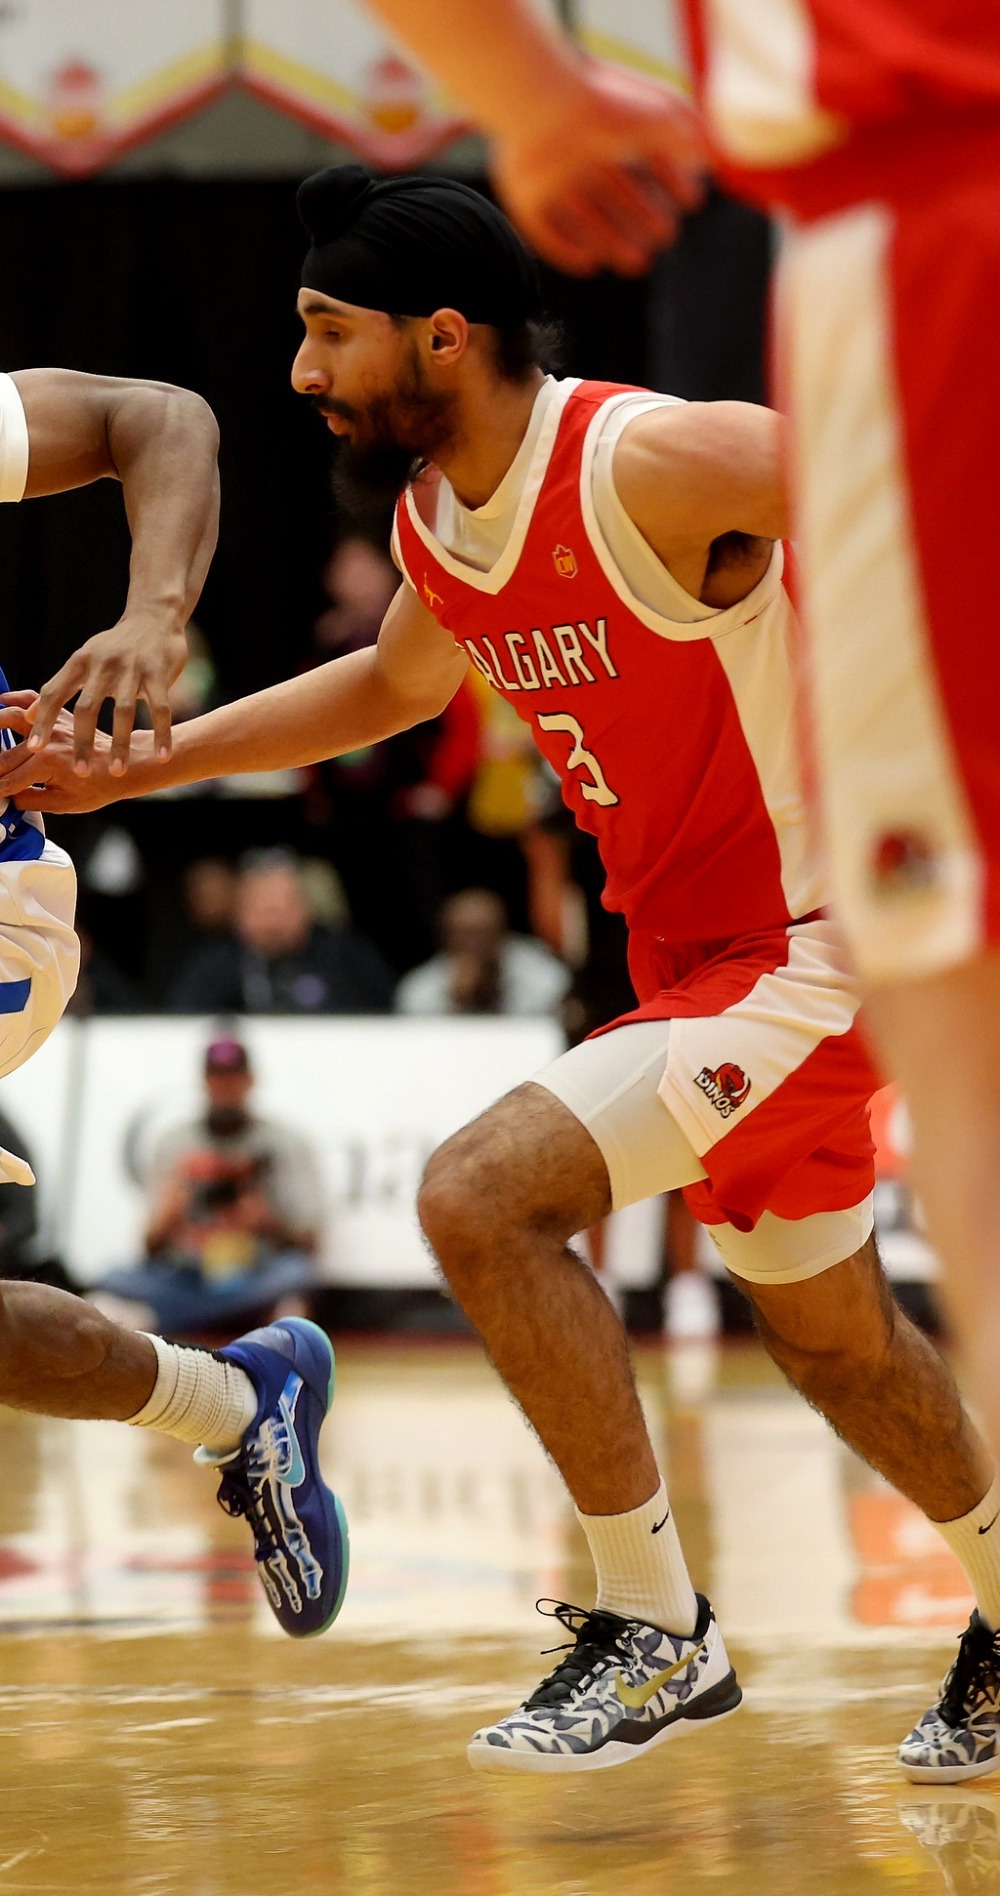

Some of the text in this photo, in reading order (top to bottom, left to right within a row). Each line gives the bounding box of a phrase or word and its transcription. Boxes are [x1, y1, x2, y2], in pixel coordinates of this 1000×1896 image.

[455, 617, 619, 692] ALGARY
[536, 711, 620, 806] 3
[694, 1071, 735, 1119] DINOS
